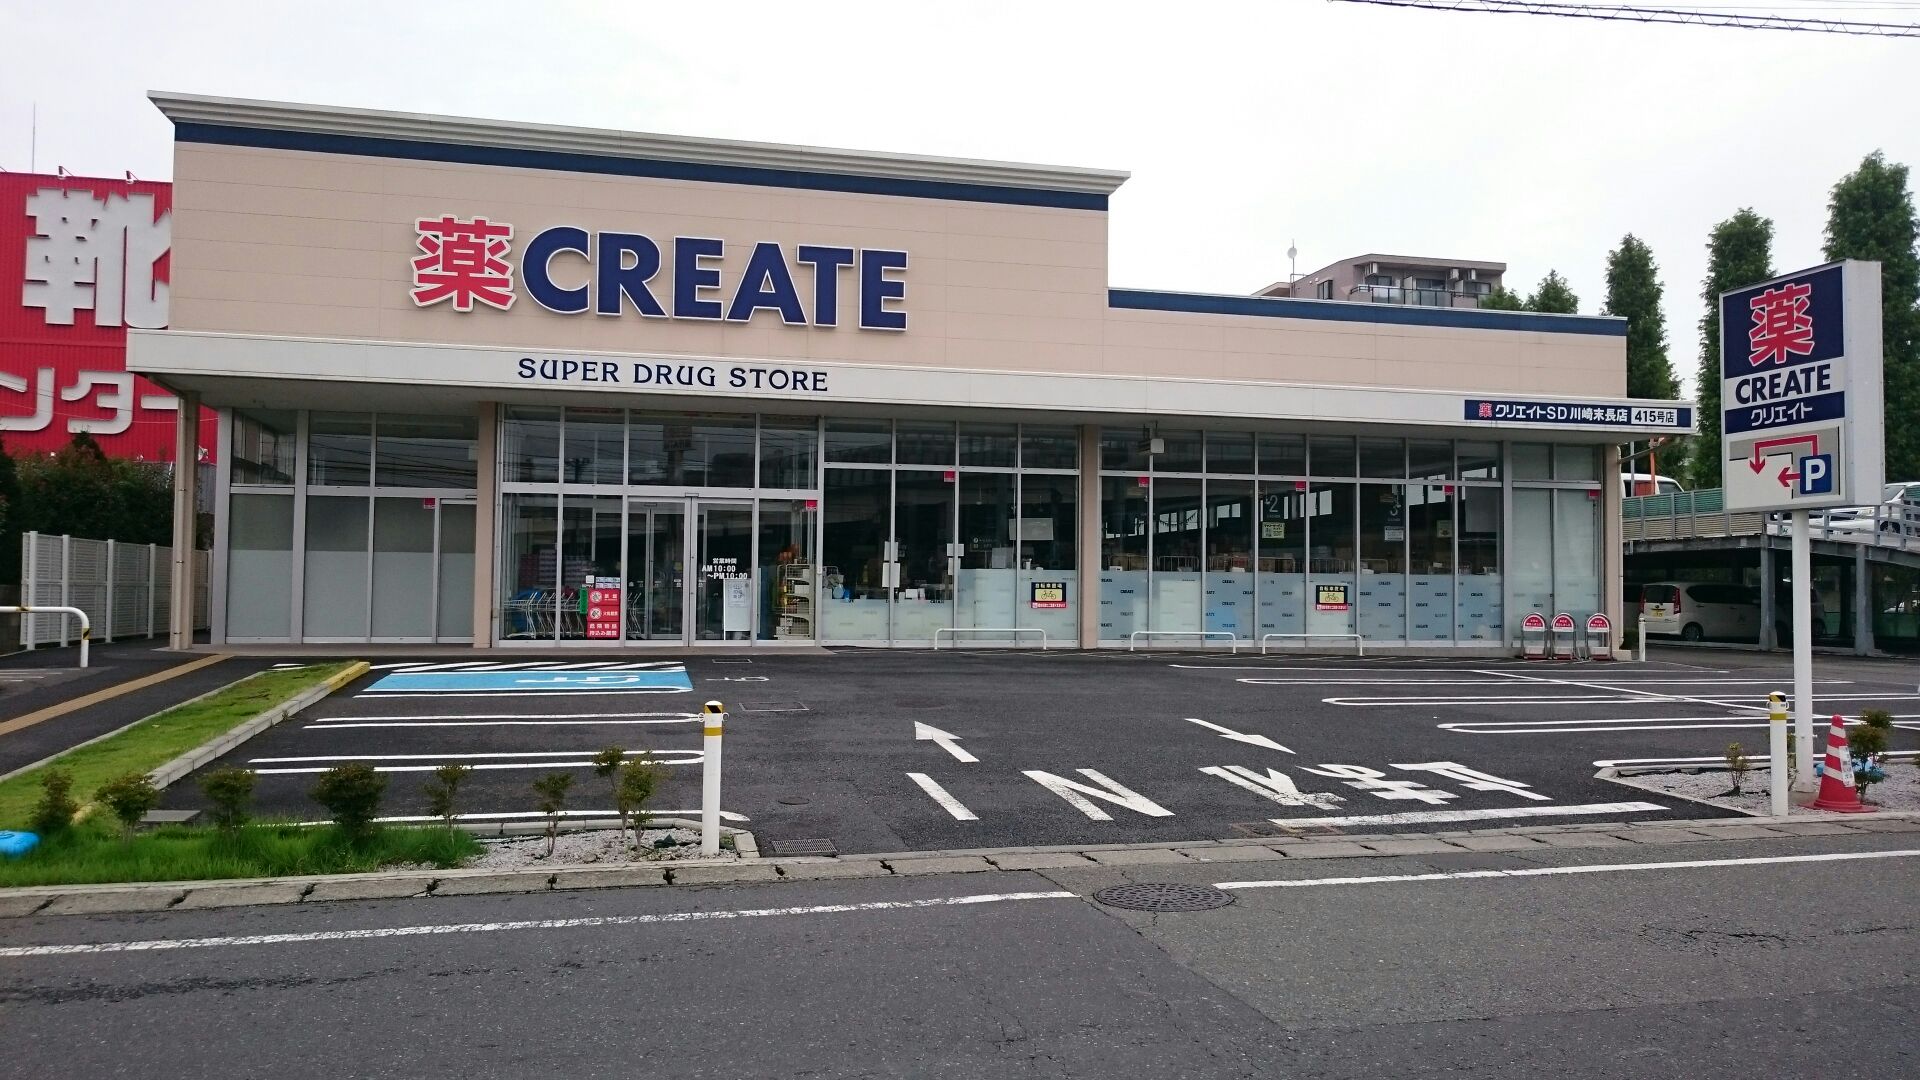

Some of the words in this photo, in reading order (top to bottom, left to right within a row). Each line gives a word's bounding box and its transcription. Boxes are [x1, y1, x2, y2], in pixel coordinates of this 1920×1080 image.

[411, 214, 515, 311] 薬
[522, 226, 908, 331] CREATE
[1749, 283, 1815, 366] 薬
[517, 357, 620, 382] SUPER
[633, 364, 716, 387] DRUG
[729, 367, 829, 392] STORE
[1735, 363, 1831, 405] CREATE
[1634, 409, 1675, 423] 415号店
[1751, 402, 1813, 427] クリエイト
[1805, 458, 1826, 491] P
[906, 768, 1176, 821] IN
